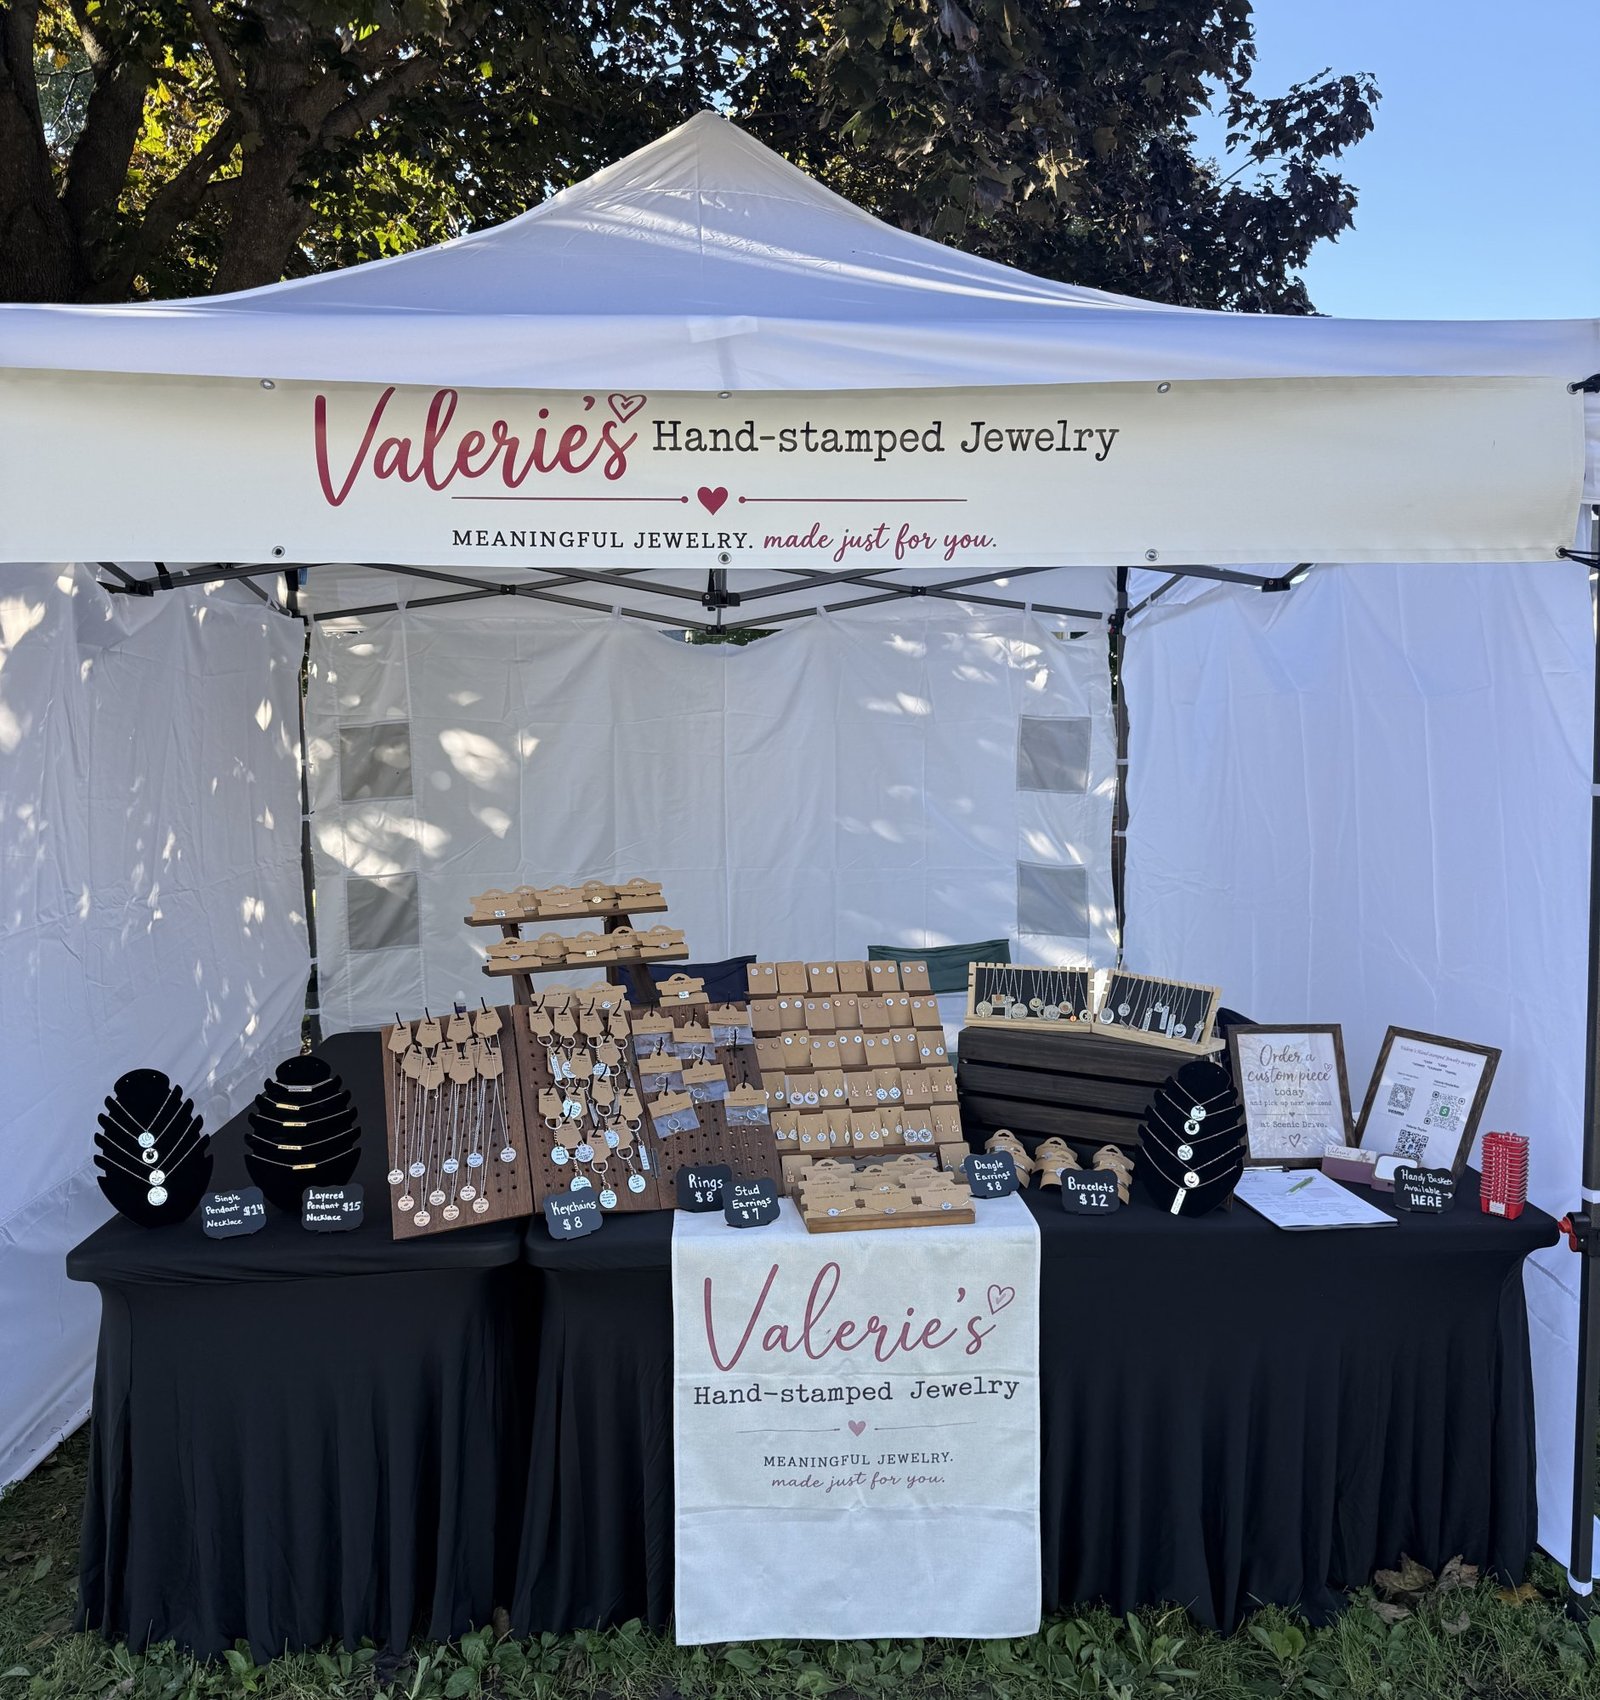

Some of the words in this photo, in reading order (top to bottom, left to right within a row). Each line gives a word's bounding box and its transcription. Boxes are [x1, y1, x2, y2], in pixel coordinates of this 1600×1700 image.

[314, 386, 638, 507] Valerie's
[652, 418, 943, 461] Hand-stamped
[960, 420, 1120, 461] Jewelry
[452, 531, 624, 549] MEANINGFUL
[634, 531, 754, 550] JEWELRY.
[763, 532, 832, 551] made
[835, 525, 891, 561] just
[893, 524, 938, 559] for
[943, 533, 998, 560] you.
[1260, 1044, 1302, 1066] Order
[1306, 1053, 1316, 1061] a
[1248, 1066, 1296, 1083] custom
[1299, 1069, 1331, 1088] piece
[1274, 1088, 1304, 1098] today
[1264, 1100, 1278, 1108] pick
[974, 1160, 1004, 1170] Dangle
[688, 1173, 724, 1190] Rings
[975, 1171, 1011, 1181] Earrings
[1401, 1168, 1426, 1184] Handy
[734, 1185, 760, 1196] Stud
[987, 1181, 1002, 1191] $8
[1067, 1176, 1115, 1193] Bracelets
[1404, 1184, 1441, 1195] Available
[214, 1195, 241, 1204] Single
[309, 1190, 344, 1201] Layered
[1079, 1193, 1109, 1207] $12
[1411, 1193, 1442, 1208] HERE
[205, 1204, 240, 1216] Pendant
[243, 1203, 265, 1217] $14
[306, 1201, 340, 1211] Pendant
[342, 1201, 362, 1212] $15
[551, 1199, 597, 1217] Keychains
[732, 1197, 772, 1210] Earrings
[206, 1218, 243, 1228] Necklace
[306, 1214, 342, 1222] Necklace
[704, 1261, 996, 1372] Valerie's
[693, 1381, 894, 1406] Hand-stamped
[909, 1375, 1020, 1400] Jewelry
[763, 1454, 871, 1467] MEANINGFUL
[877, 1451, 954, 1466] JEWELRY.
[771, 1473, 825, 1489] made
[825, 1473, 868, 1493] just
[870, 1472, 902, 1490] for
[906, 1474, 946, 1490] you.
